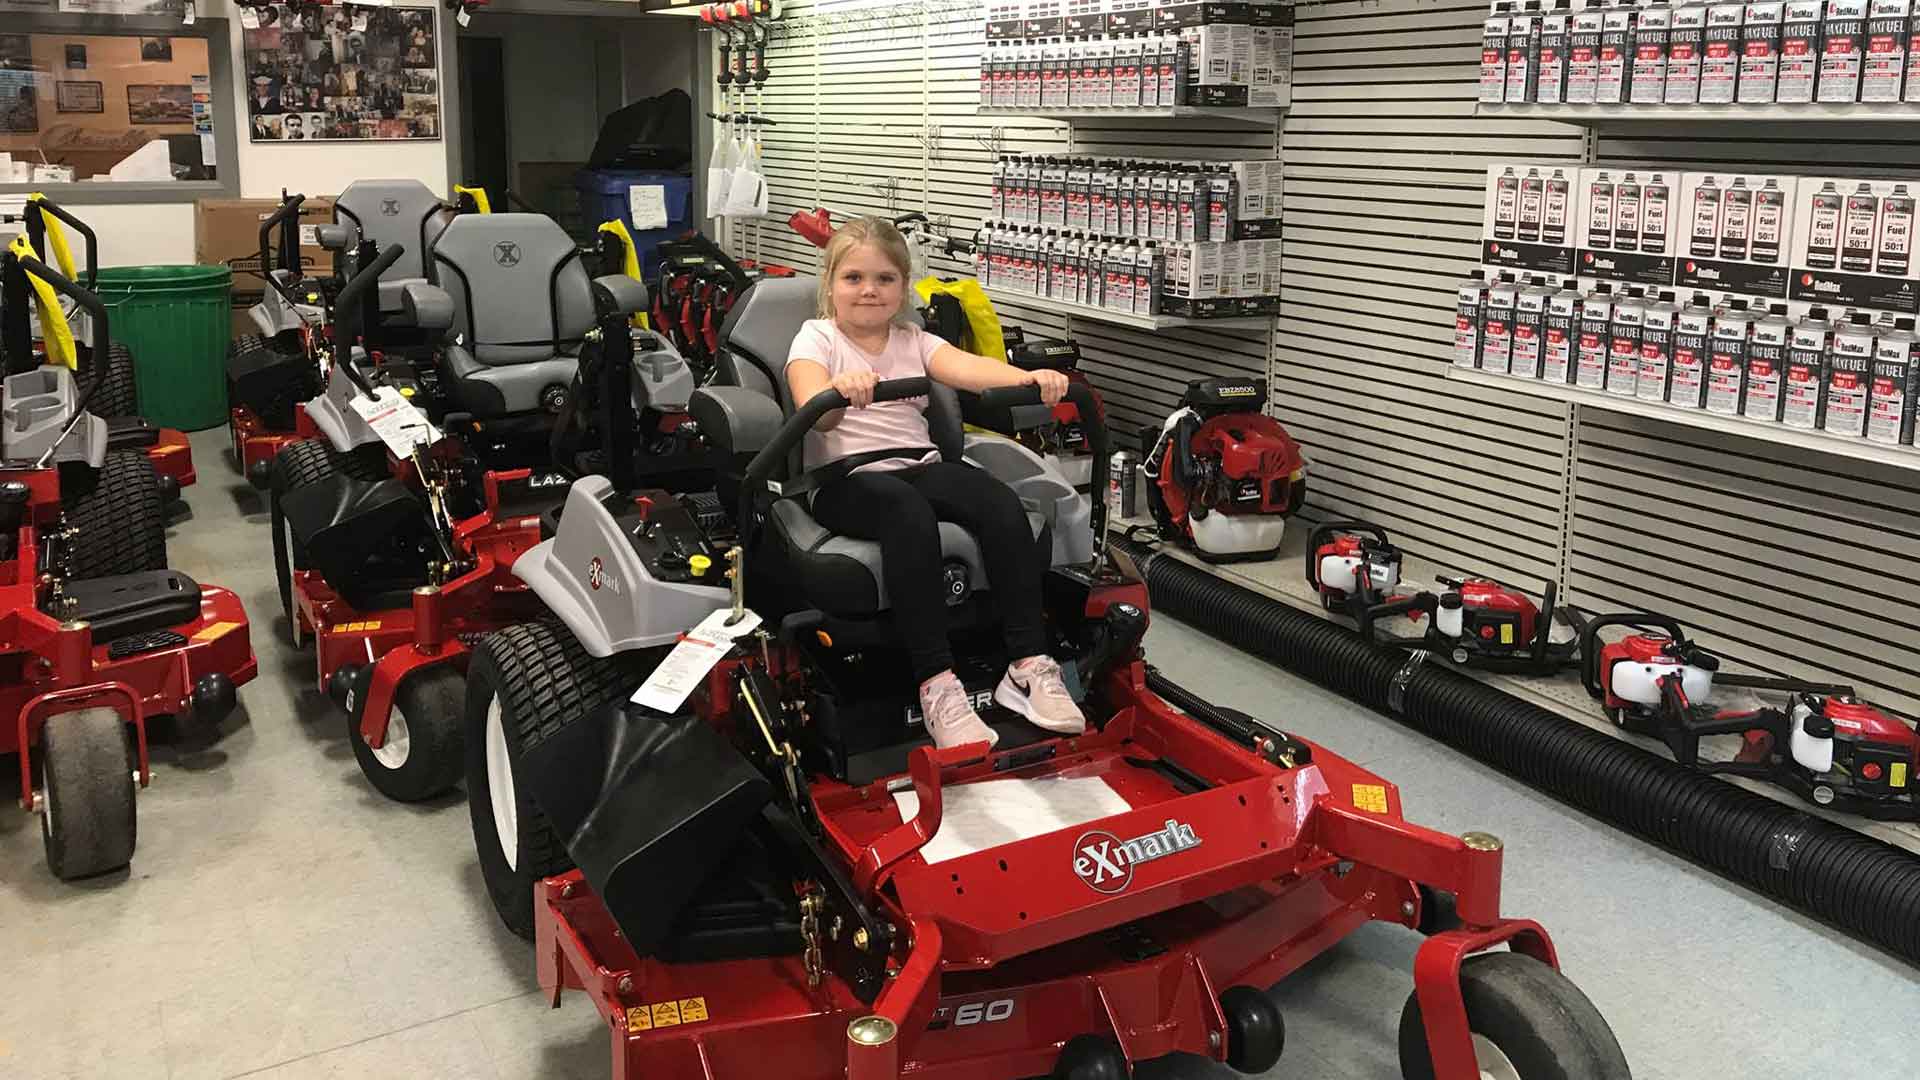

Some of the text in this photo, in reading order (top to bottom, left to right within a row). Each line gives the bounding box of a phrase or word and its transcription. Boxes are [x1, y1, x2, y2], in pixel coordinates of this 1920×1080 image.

[1524, 204, 1537, 212] Fuel
[1549, 203, 1562, 211] Fuel
[1594, 206, 1608, 214] Fuel
[1621, 211, 1635, 219] Fuel
[1648, 210, 1662, 218] Fuel
[1698, 212, 1713, 221] Fuel
[1548, 216, 1561, 224] 50:1
[1593, 220, 1607, 228] 50:1
[1728, 218, 1744, 227] Fuel
[1759, 216, 1776, 225] Fuel
[1620, 222, 1634, 230] 50:1
[1647, 223, 1661, 232] 50:1
[1816, 221, 1834, 230] Fuel
[1887, 225, 1906, 235] Fuel
[1696, 227, 1712, 236] 50:1
[1727, 229, 1743, 238] 50:1
[1850, 226, 1869, 236] Fuel
[1758, 232, 1775, 241] 50:1
[1814, 236, 1832, 246] 50:1
[1849, 239, 1867, 249] 50:1
[1885, 241, 1904, 251] 50:1
[589, 560, 620, 595] eXmark
[1074, 819, 1201, 886] eXmark
[954, 999, 1014, 1026] 60
